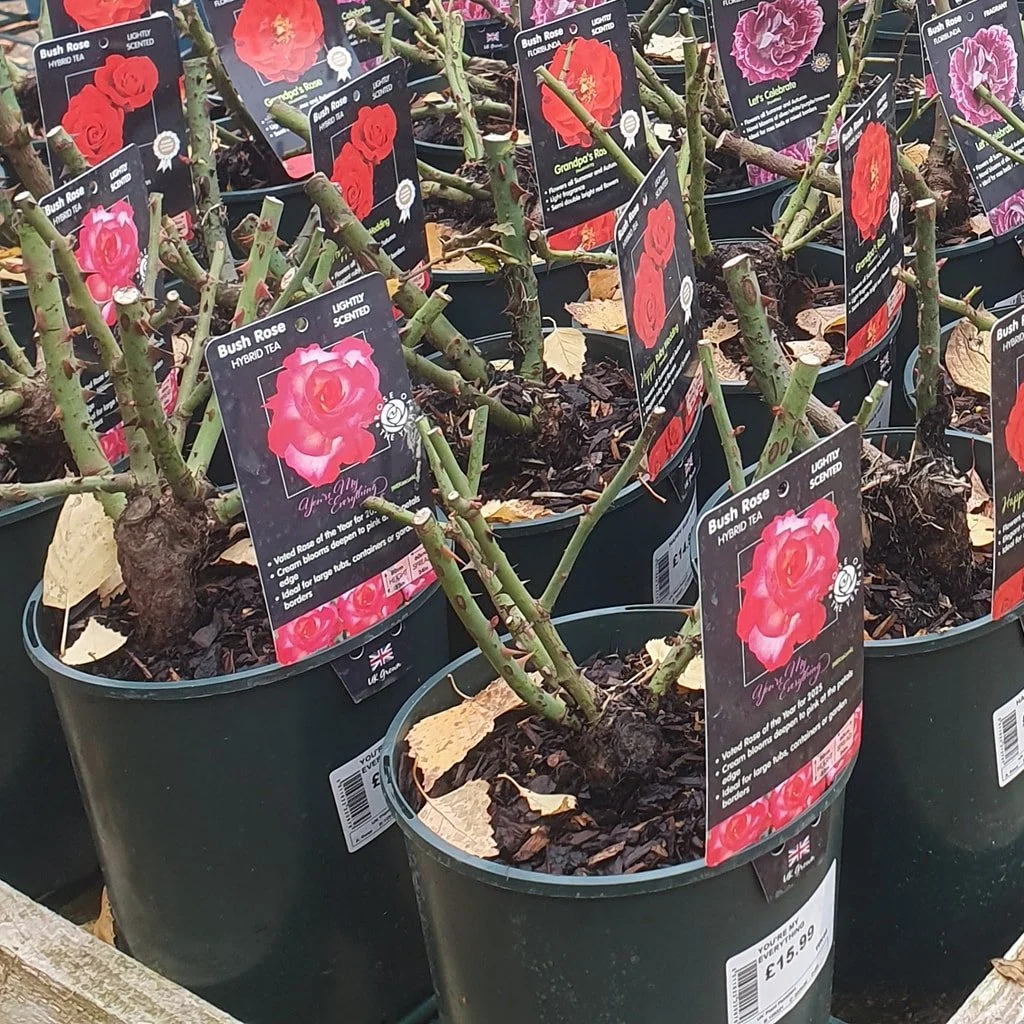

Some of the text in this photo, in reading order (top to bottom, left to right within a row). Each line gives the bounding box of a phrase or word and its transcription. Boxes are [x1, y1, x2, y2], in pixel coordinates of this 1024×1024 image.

[127, 29, 151, 41] LIGHTLY
[522, 27, 564, 49] Bush Rose
[927, 15, 963, 37] Bush Rose
[40, 38, 90, 60] Bush Rose
[73, 53, 85, 63] TEA
[126, 38, 155, 51] SCENTED
[313, 95, 348, 123] Bush Rose
[554, 147, 607, 175] Grandpa's Ros
[66, 185, 85, 204] Rose
[332, 292, 365, 314] LIGHTLY
[333, 305, 371, 328] SCENTED
[217, 322, 286, 359] Bush Rose
[996, 319, 1018, 341] Bush
[1002, 332, 1024, 352] HYBRID
[231, 342, 282, 369] HYBRID TEA
[811, 447, 840, 474] LIGHTLY
[809, 461, 843, 490] SCENTED
[708, 488, 770, 535] Bush Rose
[274, 515, 364, 565] Voted Rose of the Year for
[717, 511, 763, 546] HYBRID TEA
[277, 561, 302, 577] Cream
[303, 547, 330, 563] blooms
[331, 534, 357, 551] deepen
[358, 526, 366, 536] to
[367, 519, 381, 534] pink
[279, 573, 299, 588] edge
[282, 535, 394, 600] Ideal for large tubs, containers or
[284, 591, 313, 610] borders
[721, 682, 823, 761] Voted Rose of the Year for 2025
[721, 669, 854, 774] Cream blooms deepen to pink at the petals
[722, 698, 848, 798] Ideal for large tubs, containers or garden
[722, 769, 741, 785] edge
[722, 786, 750, 809] borders
[758, 917, 799, 954] YOU'RE MY
[758, 921, 805, 964] EVERYTHING
[765, 924, 814, 981] £15.99
